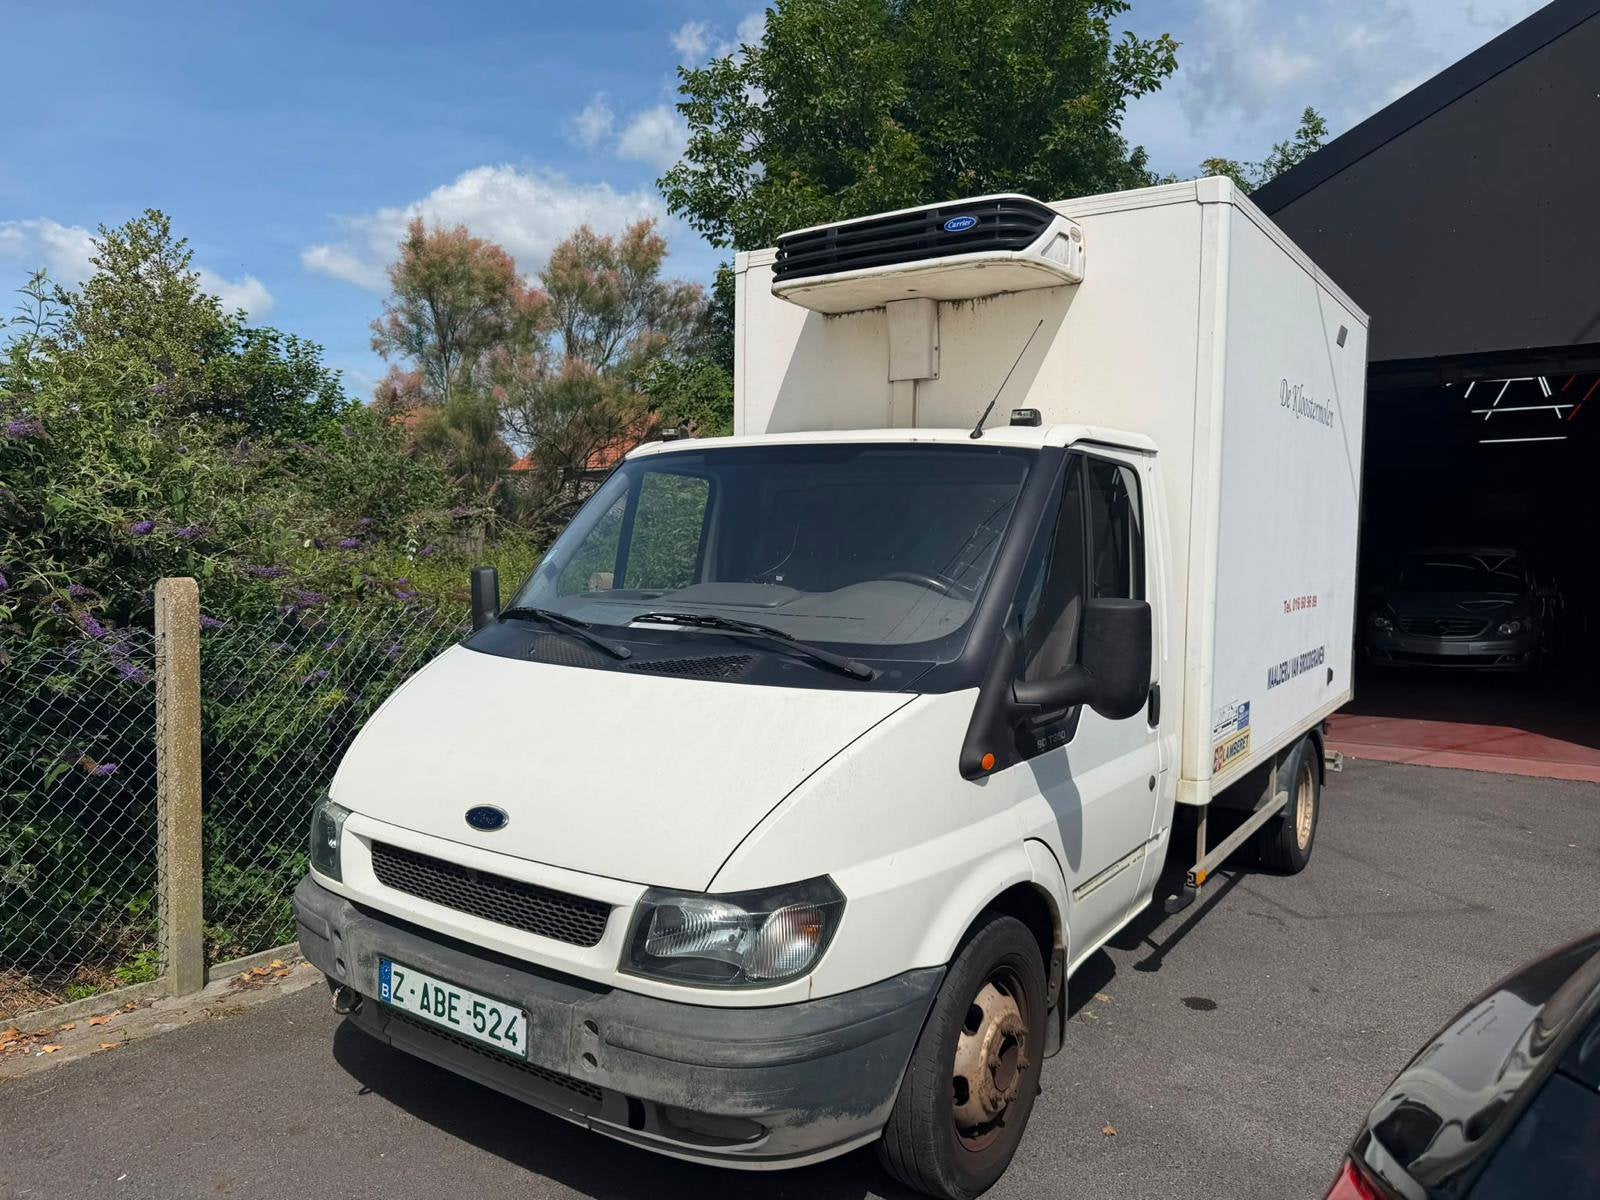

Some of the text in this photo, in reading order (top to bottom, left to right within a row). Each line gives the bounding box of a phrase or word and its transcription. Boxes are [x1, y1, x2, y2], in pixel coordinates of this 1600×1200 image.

[947, 219, 972, 229] Carrier
[1279, 378, 1291, 409] De
[381, 983, 389, 998] B
